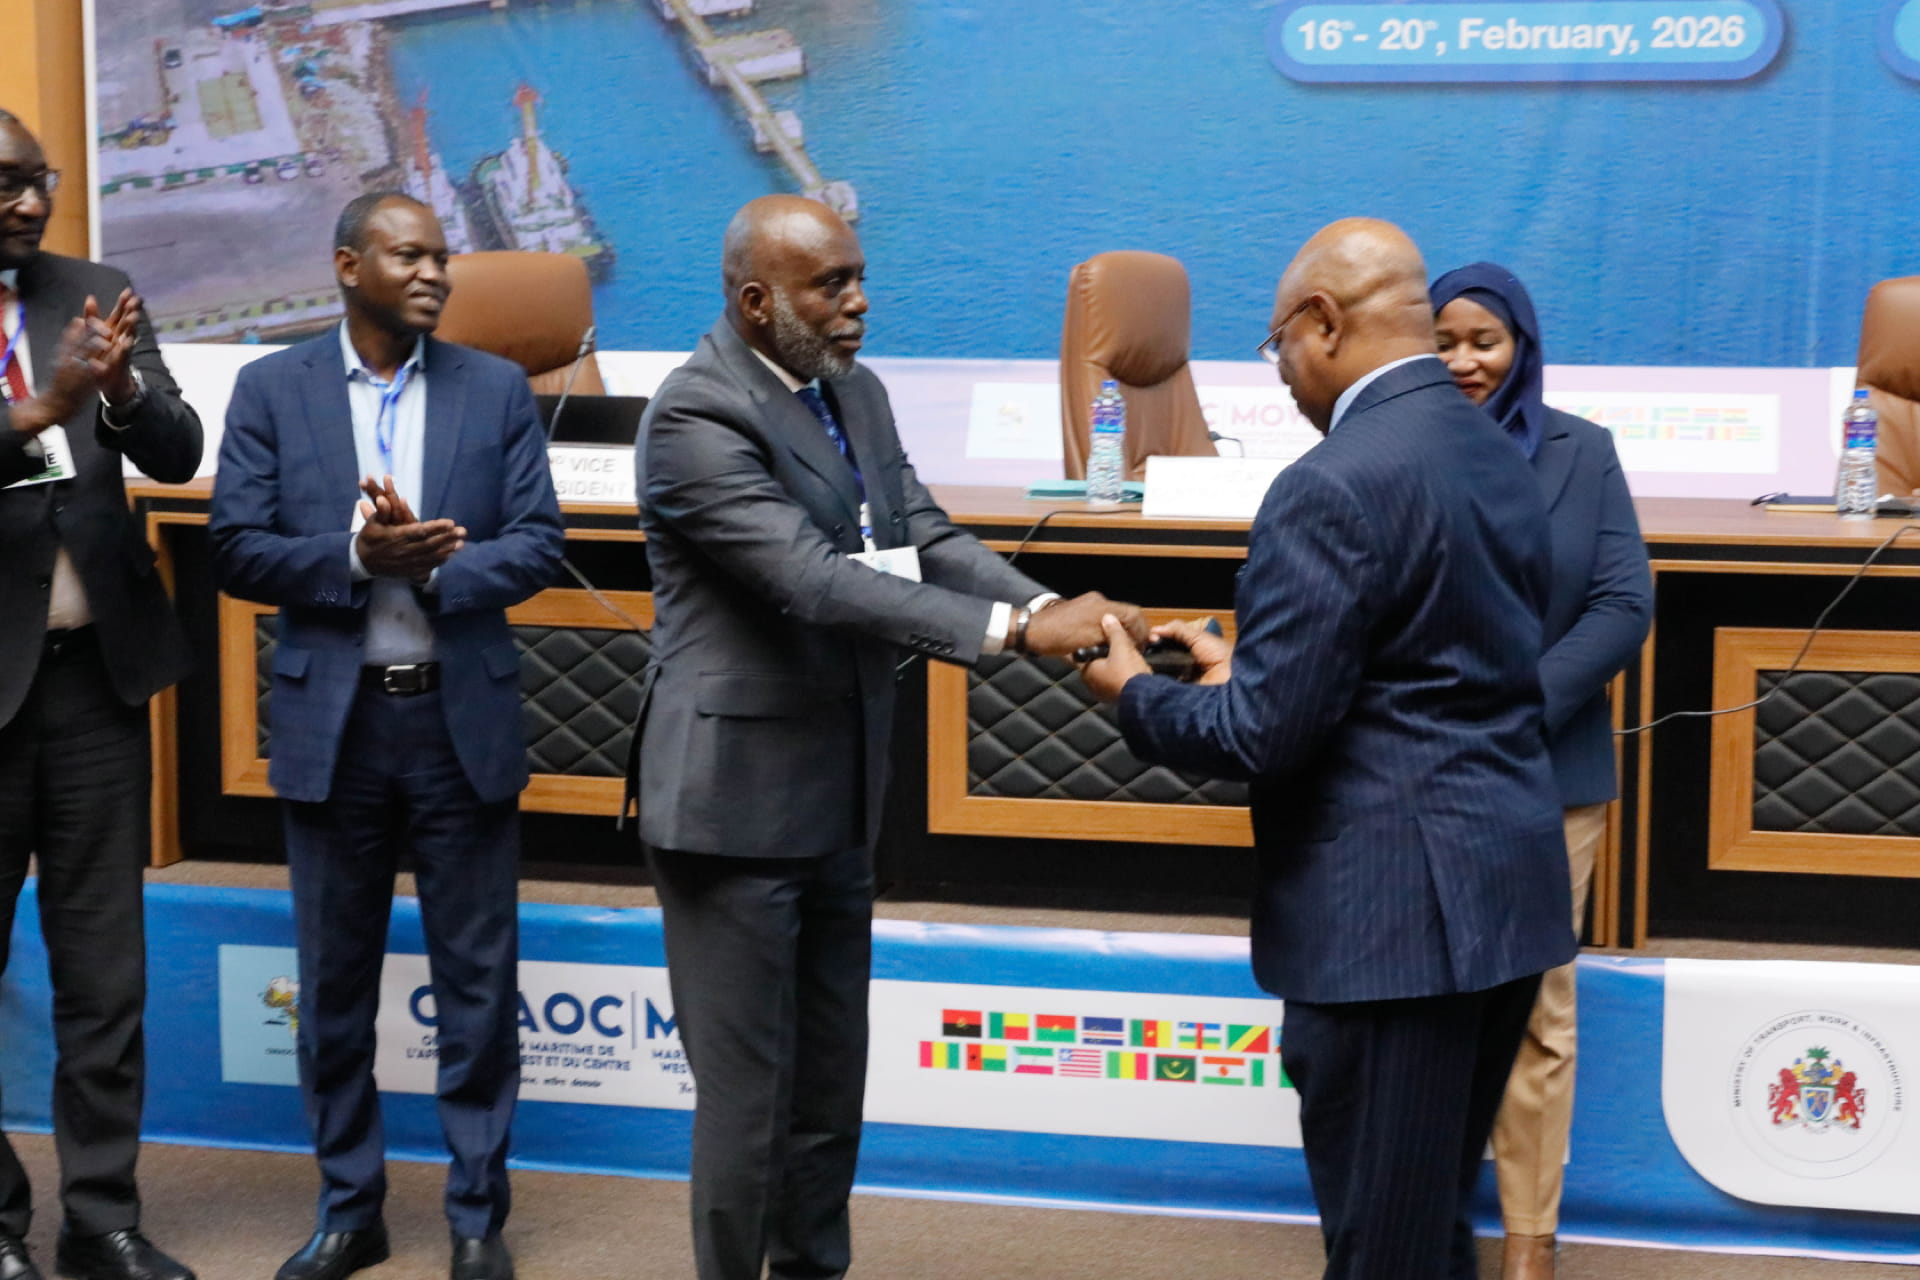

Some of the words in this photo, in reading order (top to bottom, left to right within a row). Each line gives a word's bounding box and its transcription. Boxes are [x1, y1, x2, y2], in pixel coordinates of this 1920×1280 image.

[1458, 17, 1641, 56] February,
[1651, 15, 1746, 48] 2026
[570, 456, 617, 472] VICE
[556, 480, 628, 496] SIDENT
[529, 1042, 594, 1056] MARITIME
[582, 1057, 631, 1072] CENTRE
